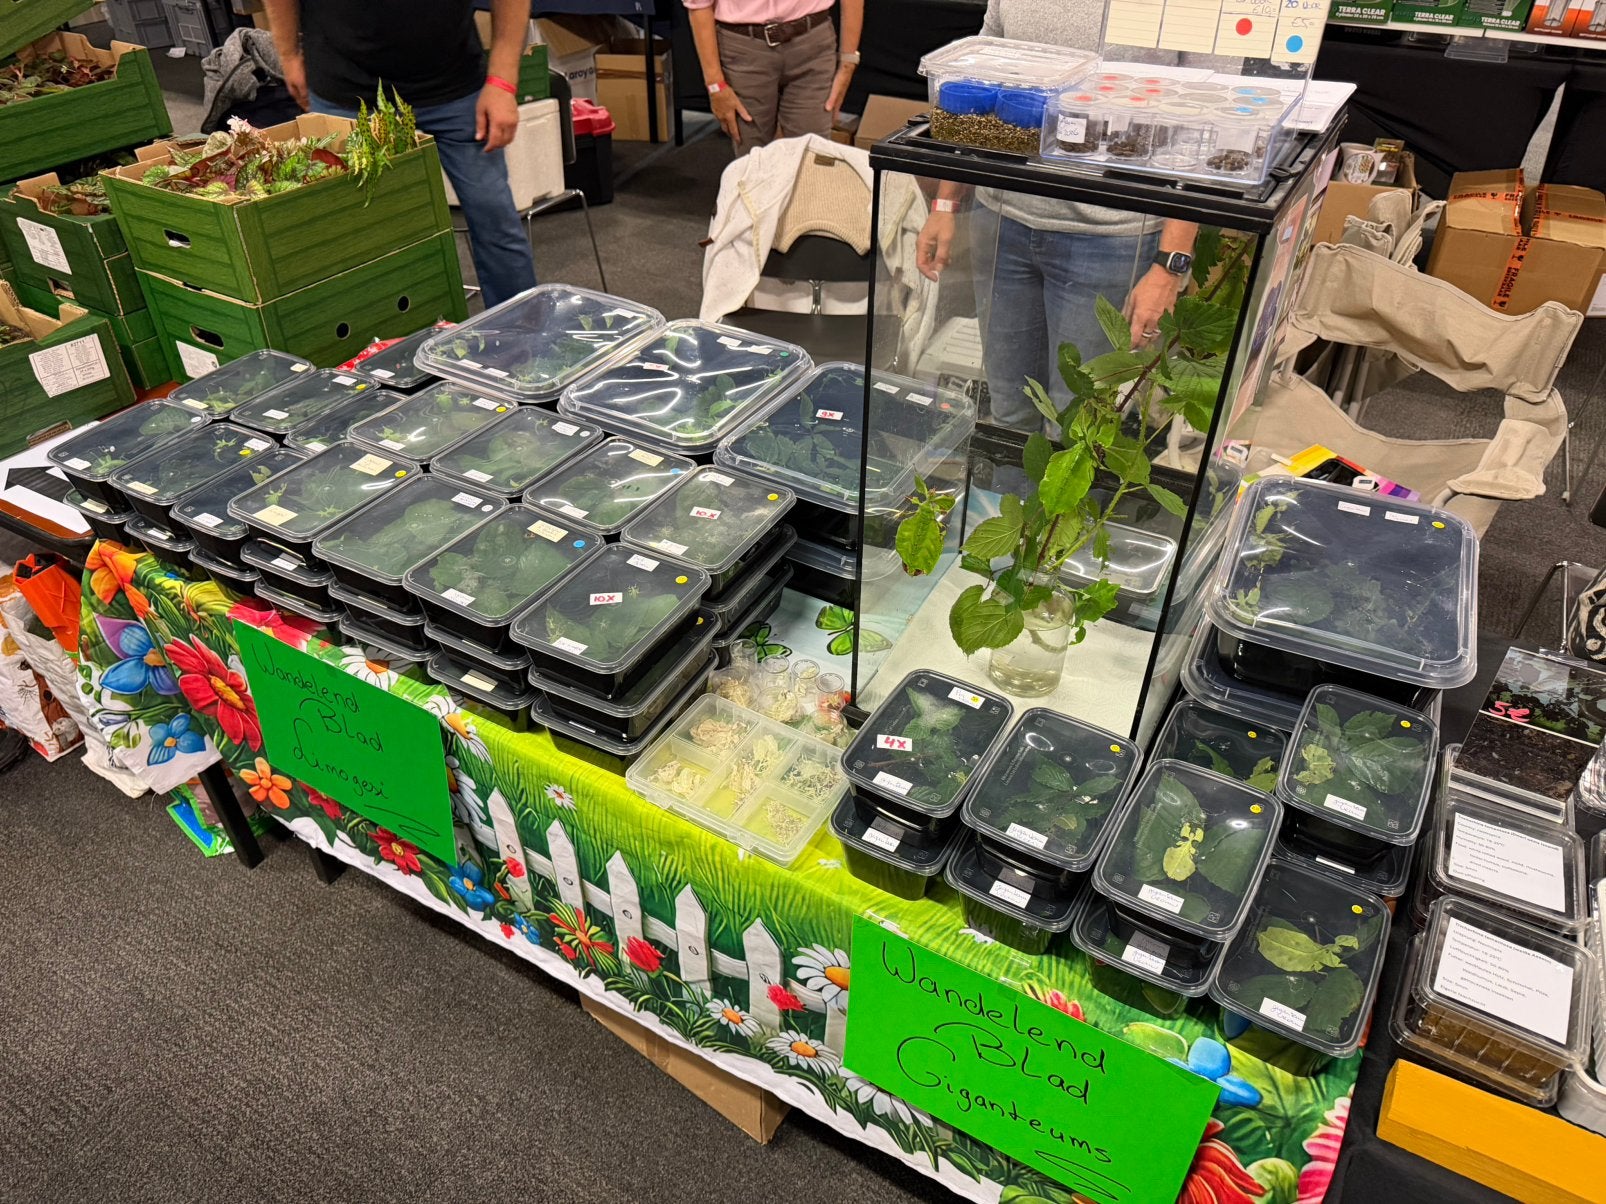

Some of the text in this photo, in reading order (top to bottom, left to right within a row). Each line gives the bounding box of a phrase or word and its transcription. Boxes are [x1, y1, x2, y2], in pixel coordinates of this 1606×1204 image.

[1338, 6, 1361, 14] TERRA
[1362, 8, 1386, 16] CLEAR
[1481, 16, 1501, 24] TERRA
[1501, 18, 1520, 26] CLEAR
[1502, 267, 1519, 298] FRAGILE
[252, 642, 360, 714] Wandelend
[881, 940, 1107, 1075] Wandelend
[896, 1035, 1113, 1164] Giganteums
